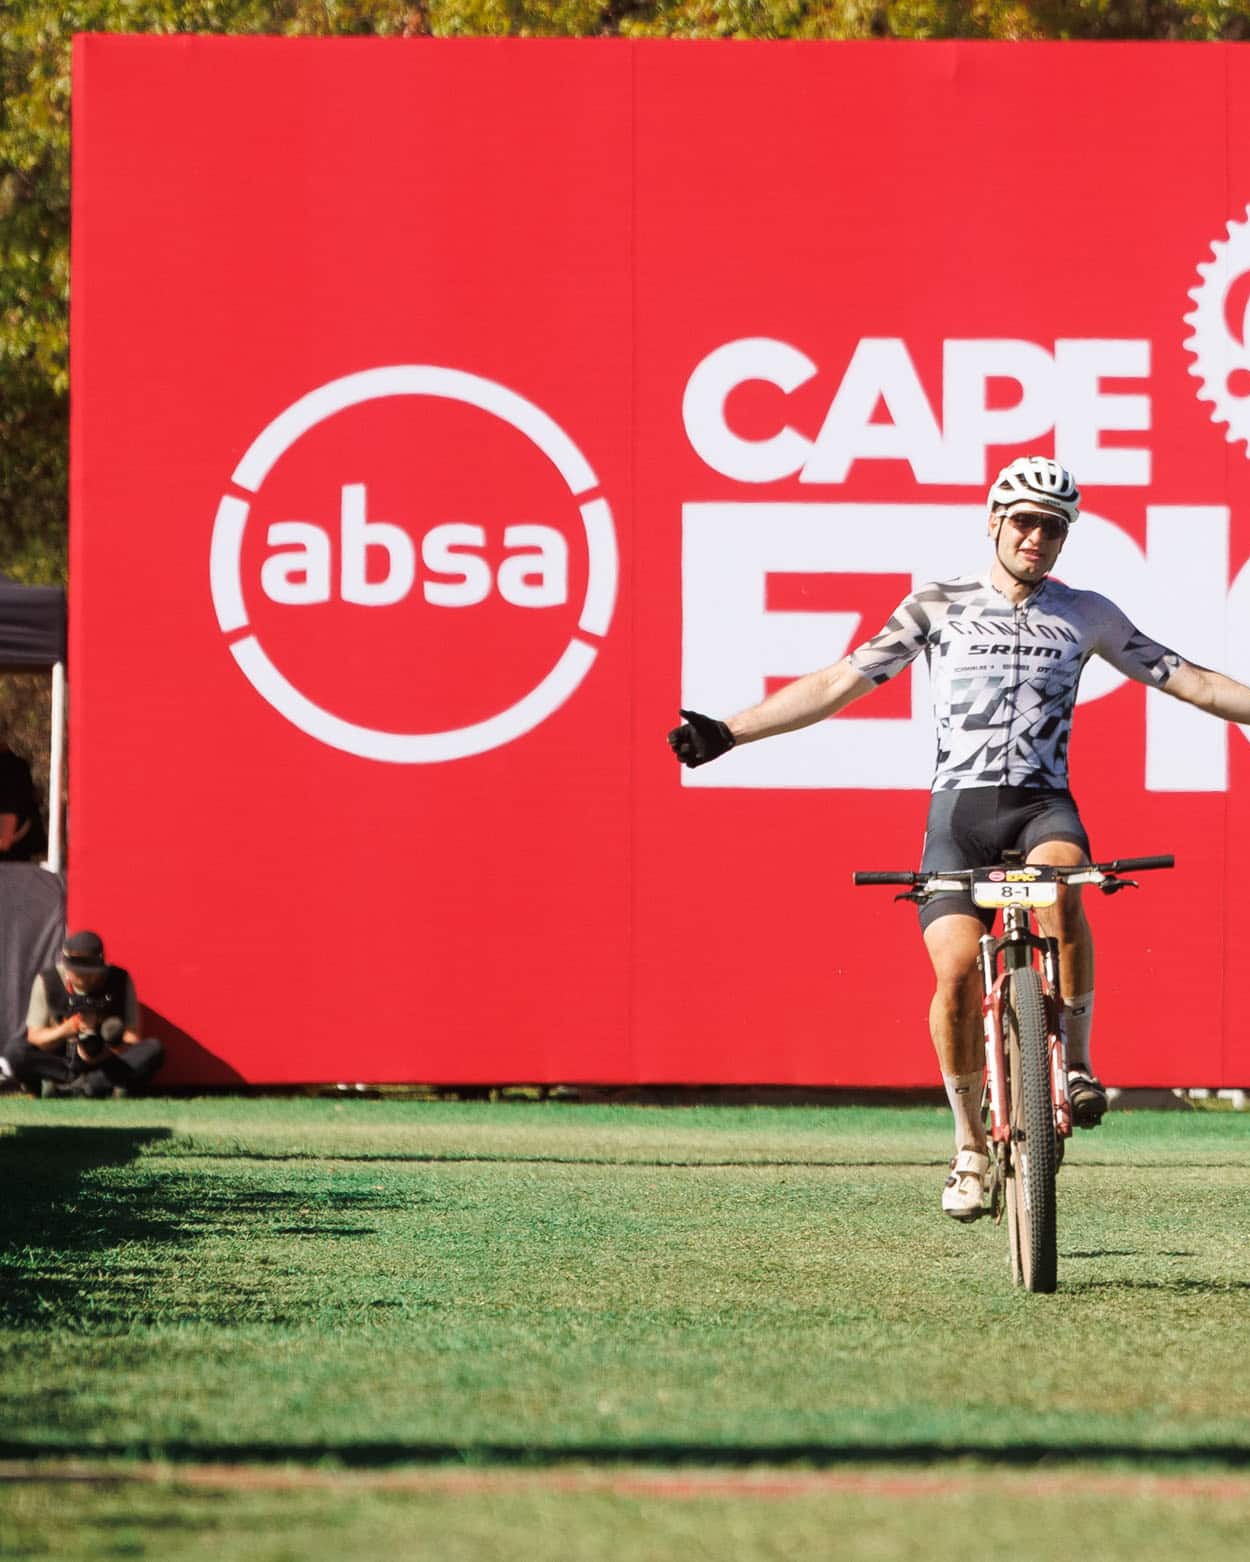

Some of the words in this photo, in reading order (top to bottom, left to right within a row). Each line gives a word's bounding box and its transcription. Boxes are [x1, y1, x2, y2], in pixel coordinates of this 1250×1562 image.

[682, 337, 1152, 486] CAPE
[260, 483, 569, 608] absa
[949, 620, 1080, 645] CANYON
[968, 644, 1063, 660] SRAM
[1001, 886, 1030, 898] 8-1
